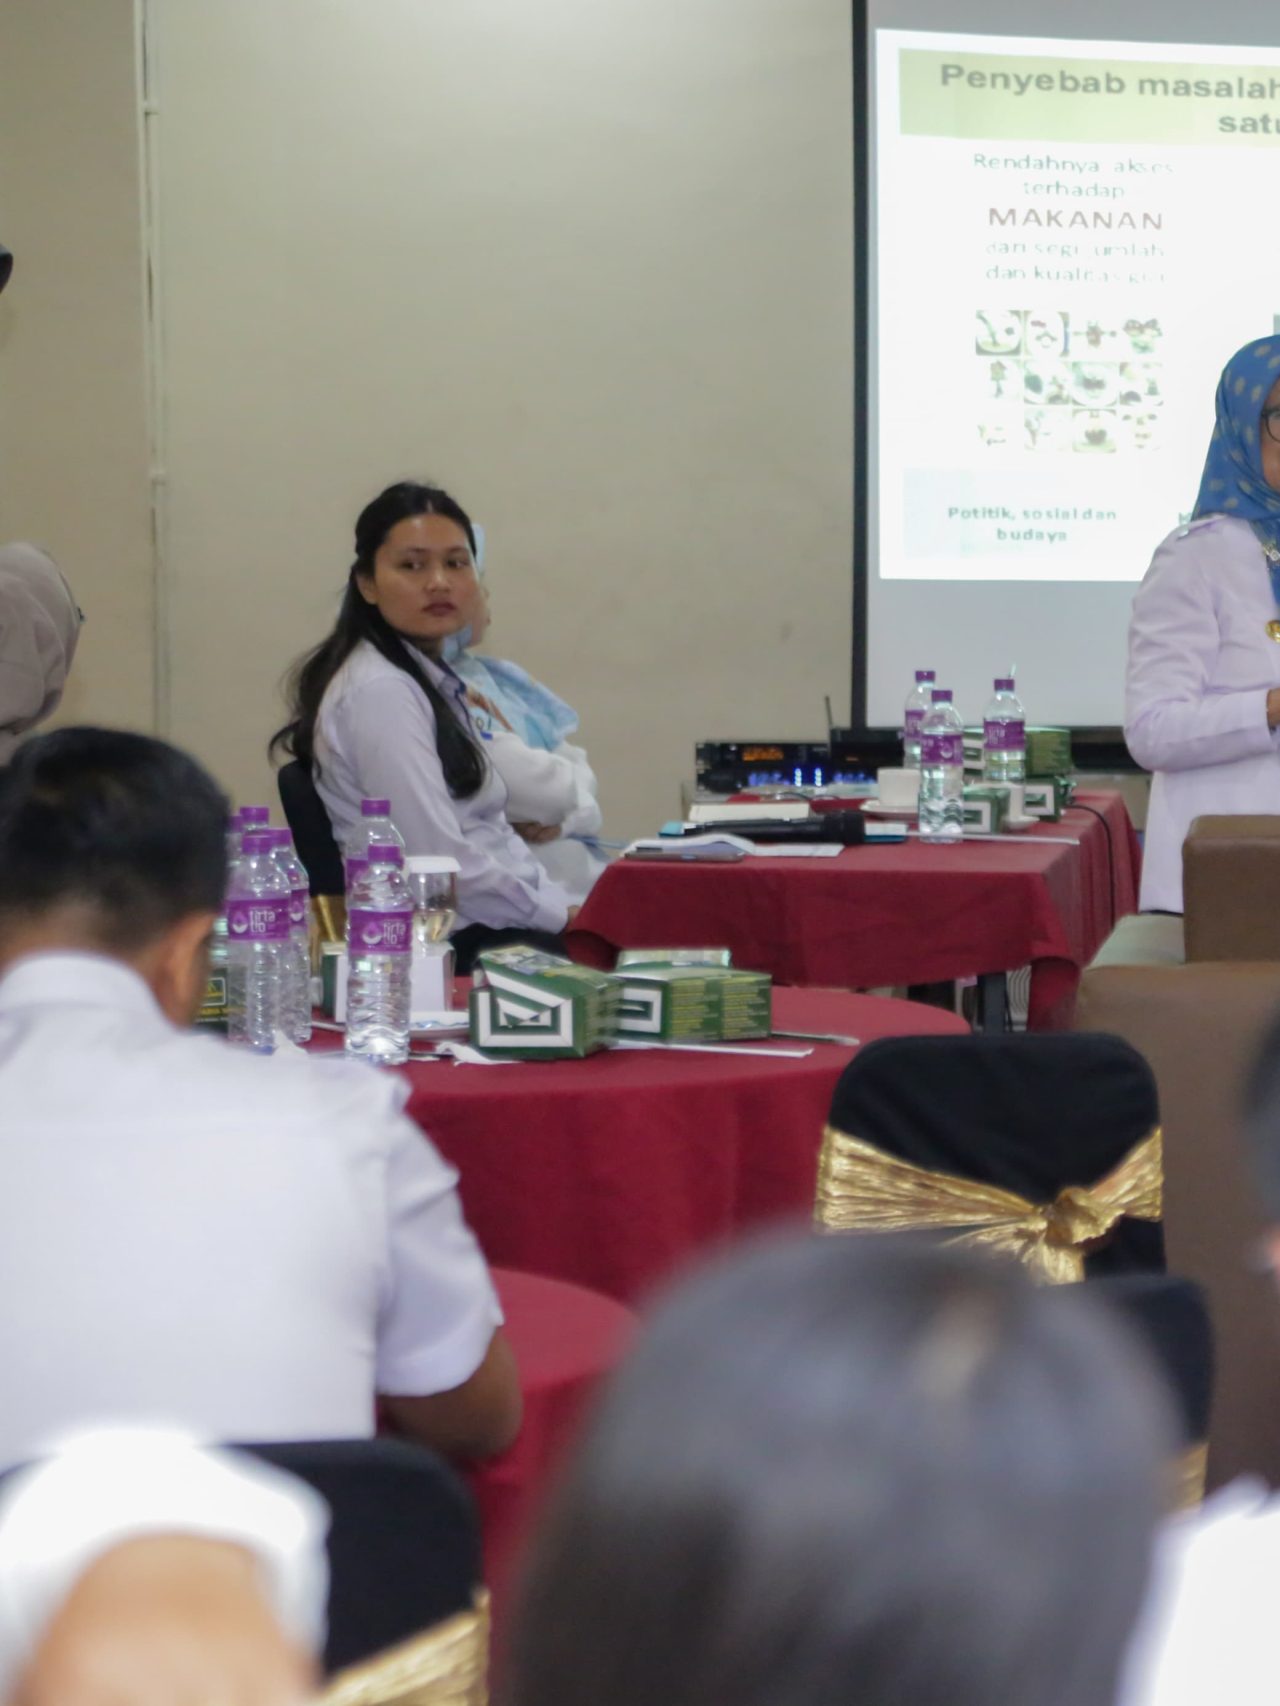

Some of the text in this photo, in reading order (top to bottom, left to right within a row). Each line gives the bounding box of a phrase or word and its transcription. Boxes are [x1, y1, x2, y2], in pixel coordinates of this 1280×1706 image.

[940, 63, 1126, 96] Penyebab
[973, 153, 1100, 174] Rendahnya
[1023, 181, 1125, 200] terhadap
[988, 207, 1163, 231] MAKANAN
[1081, 508, 1117, 521] dan
[997, 528, 1068, 544] budaya
